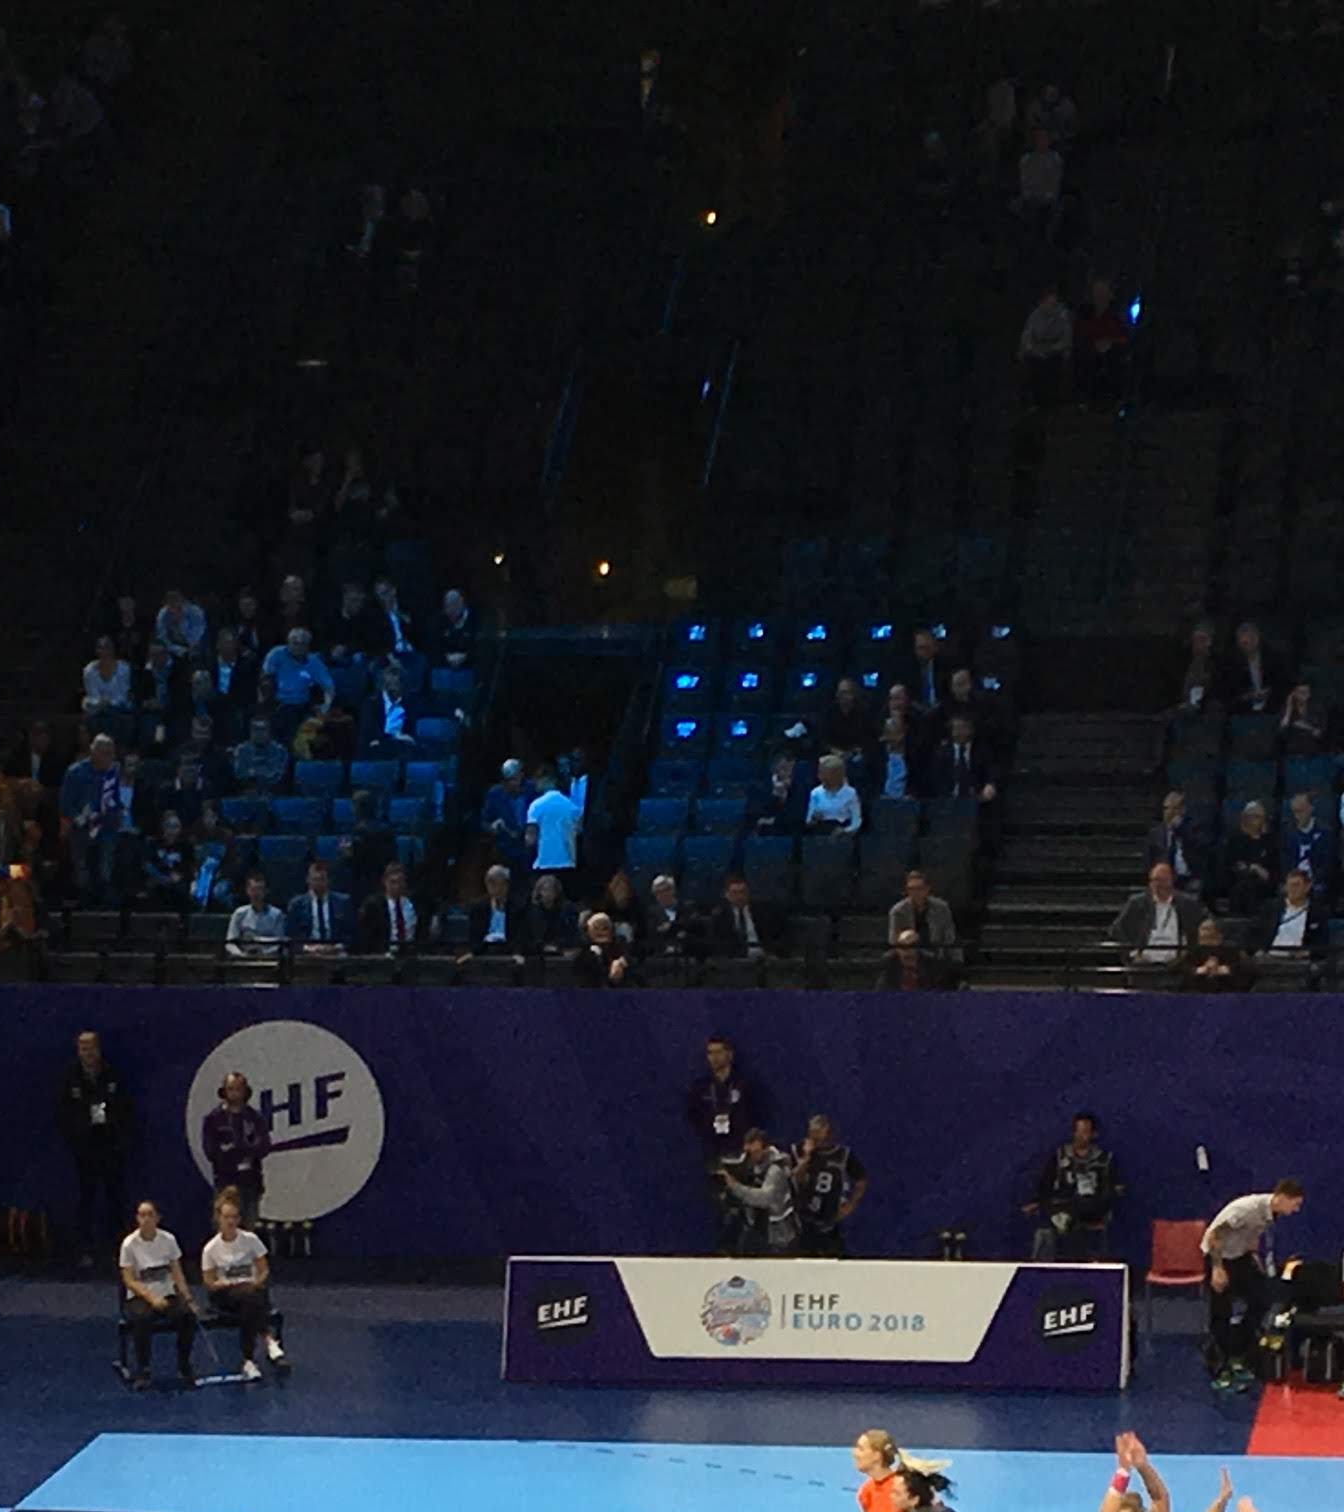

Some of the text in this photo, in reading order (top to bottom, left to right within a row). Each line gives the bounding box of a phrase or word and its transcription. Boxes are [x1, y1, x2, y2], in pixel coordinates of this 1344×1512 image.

[260, 1071, 346, 1131] HF
[537, 1295, 589, 1323] EHF
[792, 1293, 840, 1311] EHF
[1043, 1302, 1096, 1330] EHF
[792, 1313, 926, 1332] EURO 2018
